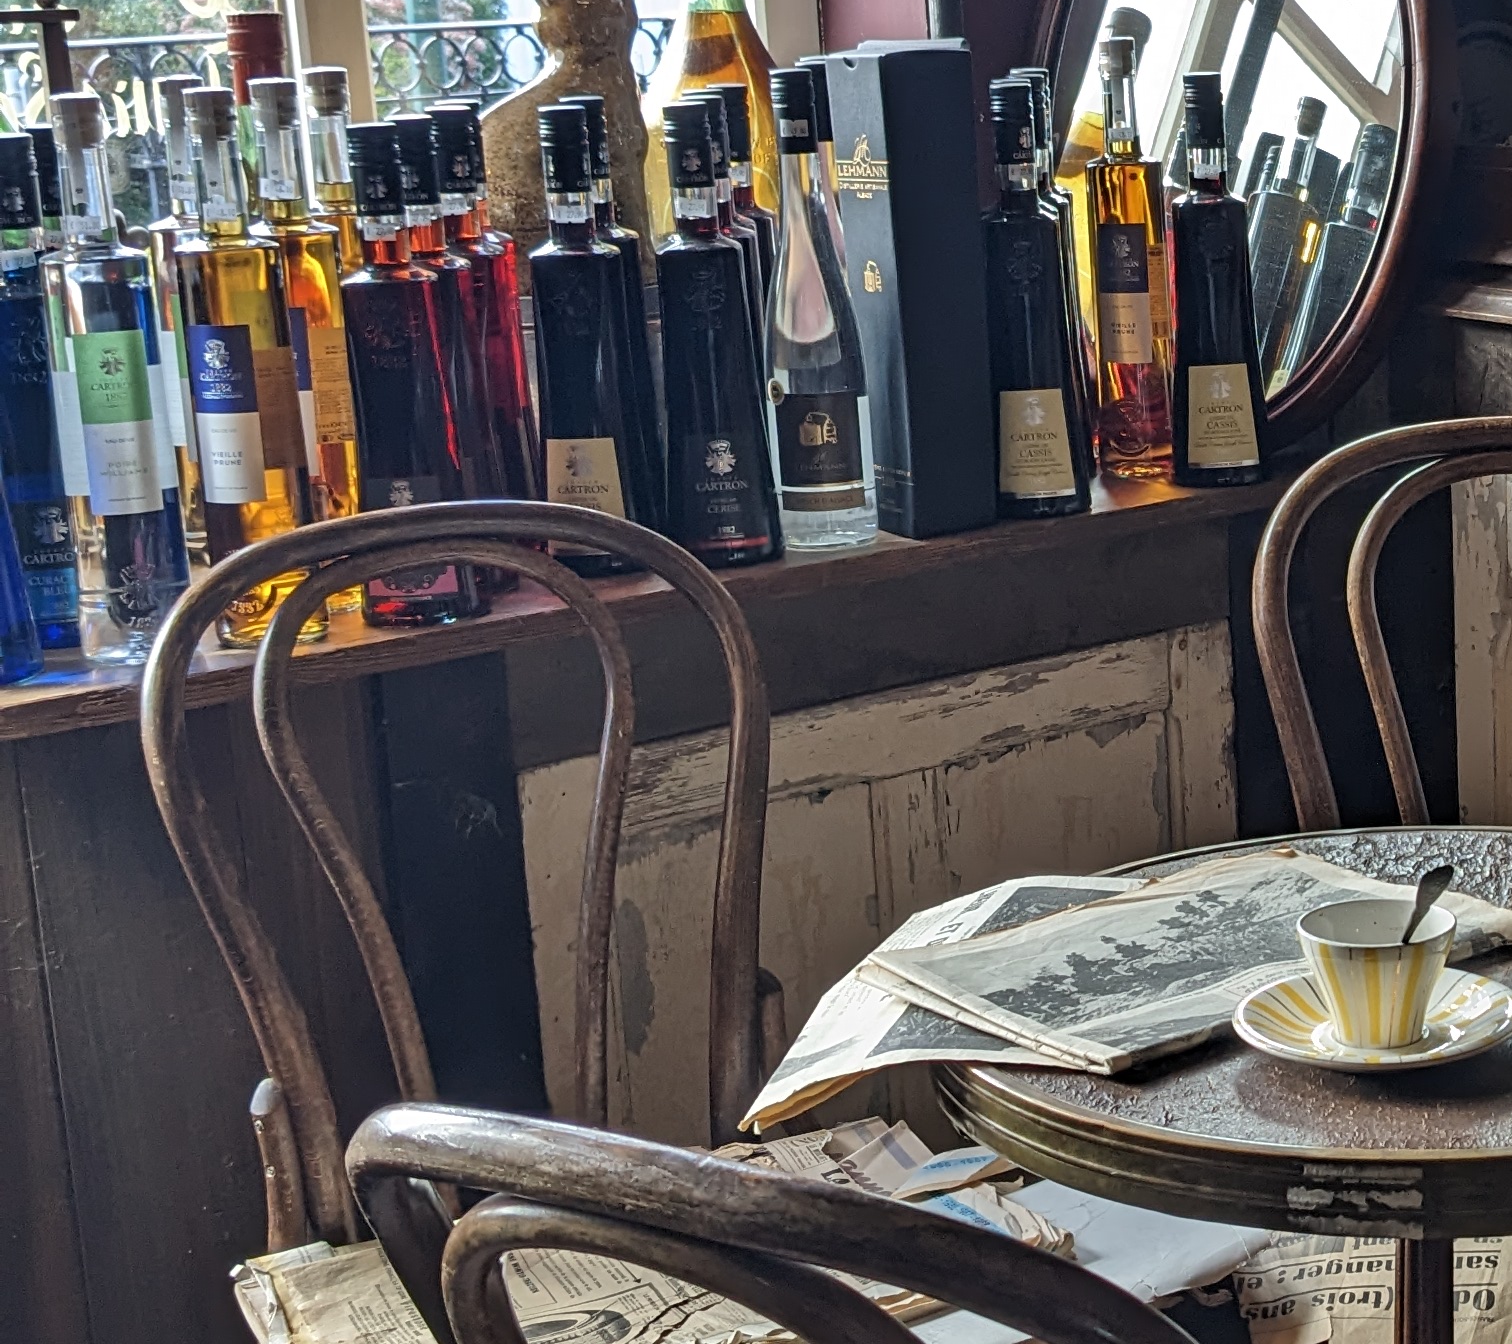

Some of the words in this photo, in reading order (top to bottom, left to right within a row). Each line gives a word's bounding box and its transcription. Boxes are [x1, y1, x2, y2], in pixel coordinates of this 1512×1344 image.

[837, 164, 887, 178] LEHMANN
[1198, 404, 1244, 415] CARTRON
[1206, 421, 1239, 430] CASSIS
[1010, 431, 1058, 442] CARTRON
[211, 451, 243, 459] VIEILLE
[1020, 448, 1053, 458] CASSIS
[557, 484, 609, 495] CARTRON
[695, 479, 749, 492] CARTRON
[22, 551, 76, 565] CARTRO
[1312, 1284, 1394, 1313] (trois
